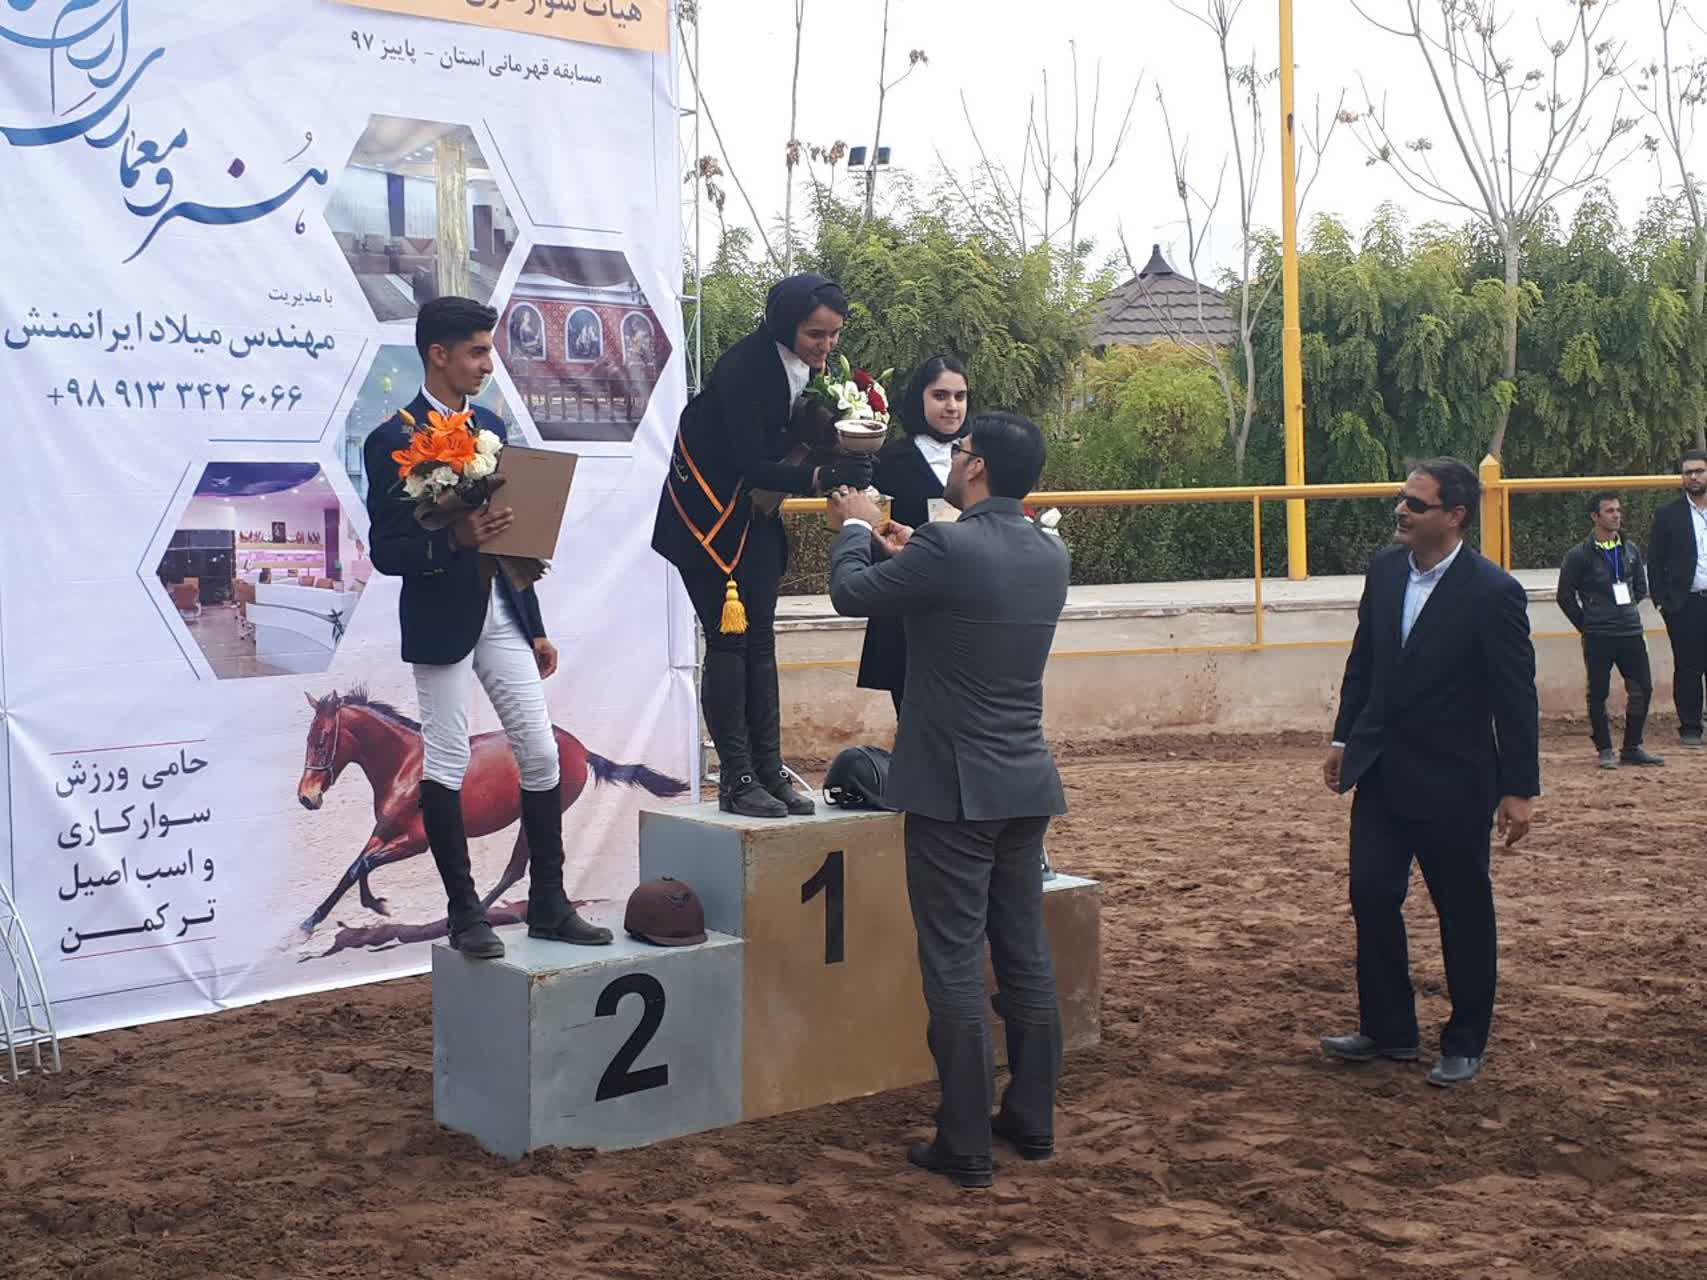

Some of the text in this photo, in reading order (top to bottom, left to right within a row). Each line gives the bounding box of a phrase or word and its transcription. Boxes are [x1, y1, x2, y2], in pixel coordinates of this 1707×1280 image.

[350, 30, 374, 51] ۹۷
[379, 39, 416, 63] پاییز
[439, 46, 486, 69] استان
[488, 54, 550, 77] قهرمانی
[552, 64, 602, 85] مسابقه
[4, 306, 336, 359] مهندس میلاد ایرانمنش
[46, 378, 303, 412] +۹۸ ۹۱۳ ۳۴۲ ۶۰۶۶
[55, 748, 209, 798] حامی ورزش
[57, 801, 212, 849] سوارکاری
[58, 847, 216, 901] و اسب اصیل
[60, 899, 217, 953] ترکمن
[801, 851, 844, 965] 1
[595, 973, 668, 1101] 2
